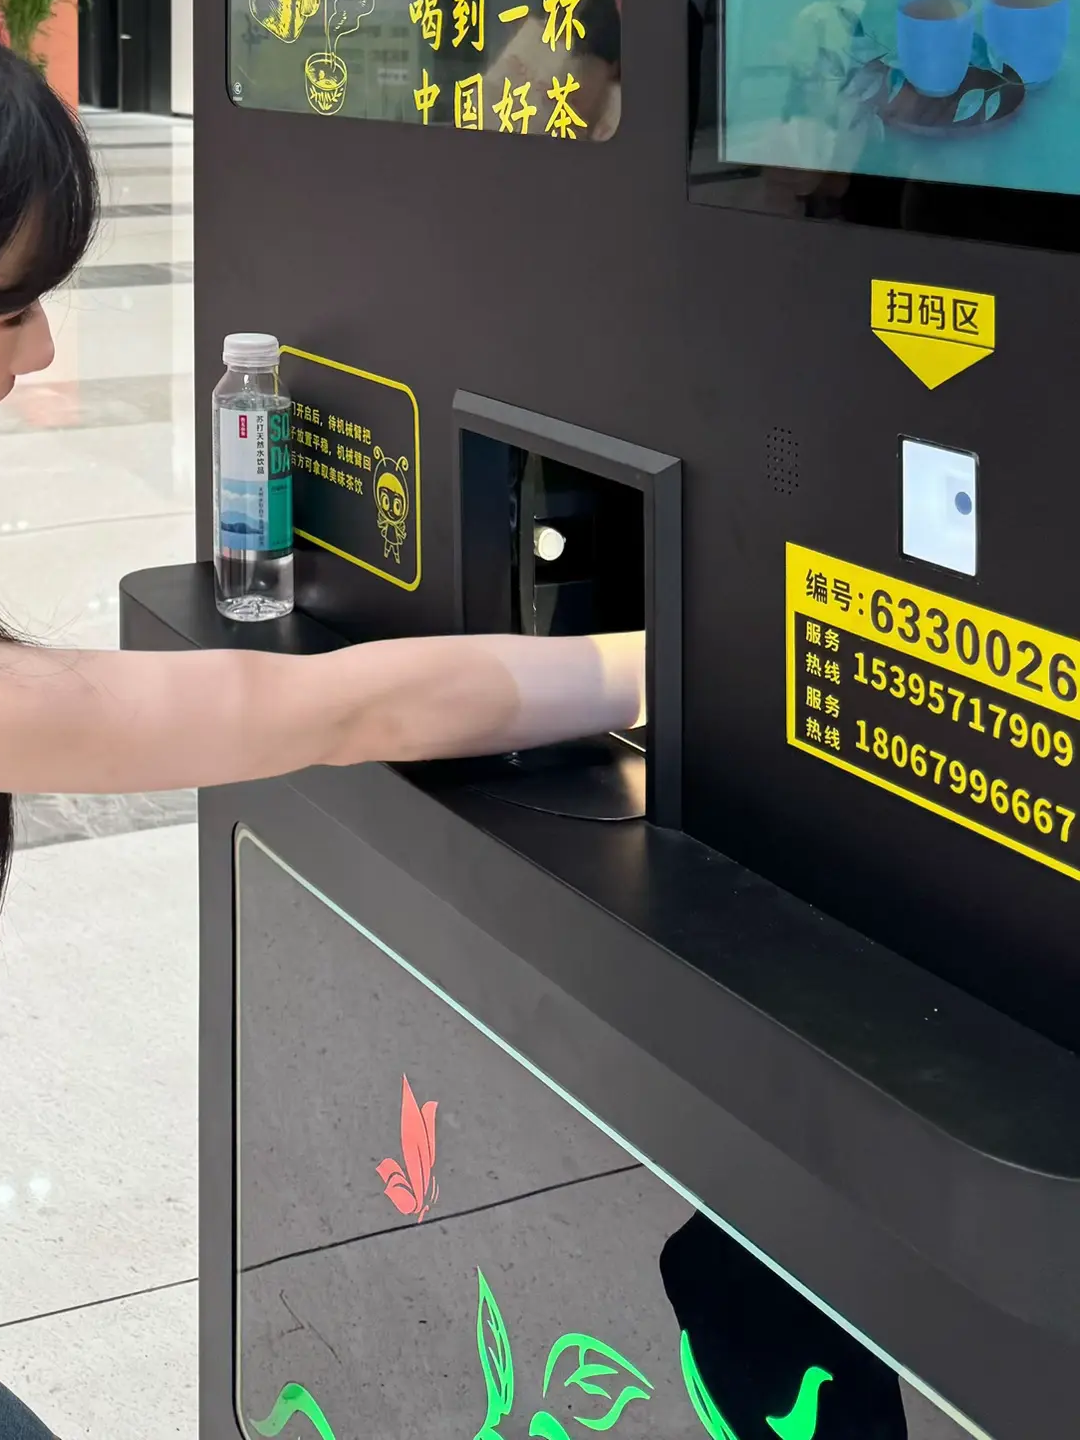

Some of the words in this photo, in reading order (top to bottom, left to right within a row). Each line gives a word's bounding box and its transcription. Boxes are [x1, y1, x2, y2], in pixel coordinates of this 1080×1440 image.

[413, 68, 588, 140] 中国好茶
[886, 289, 980, 336] 扫码区
[256, 415, 265, 475] 苏打天然水饮品
[806, 621, 839, 652] 服务
[806, 651, 841, 685] 热线
[806, 685, 839, 719] 服务
[854, 652, 1073, 767] 15395717909
[806, 716, 841, 751] 热线
[855, 719, 1076, 843] 18067996667
